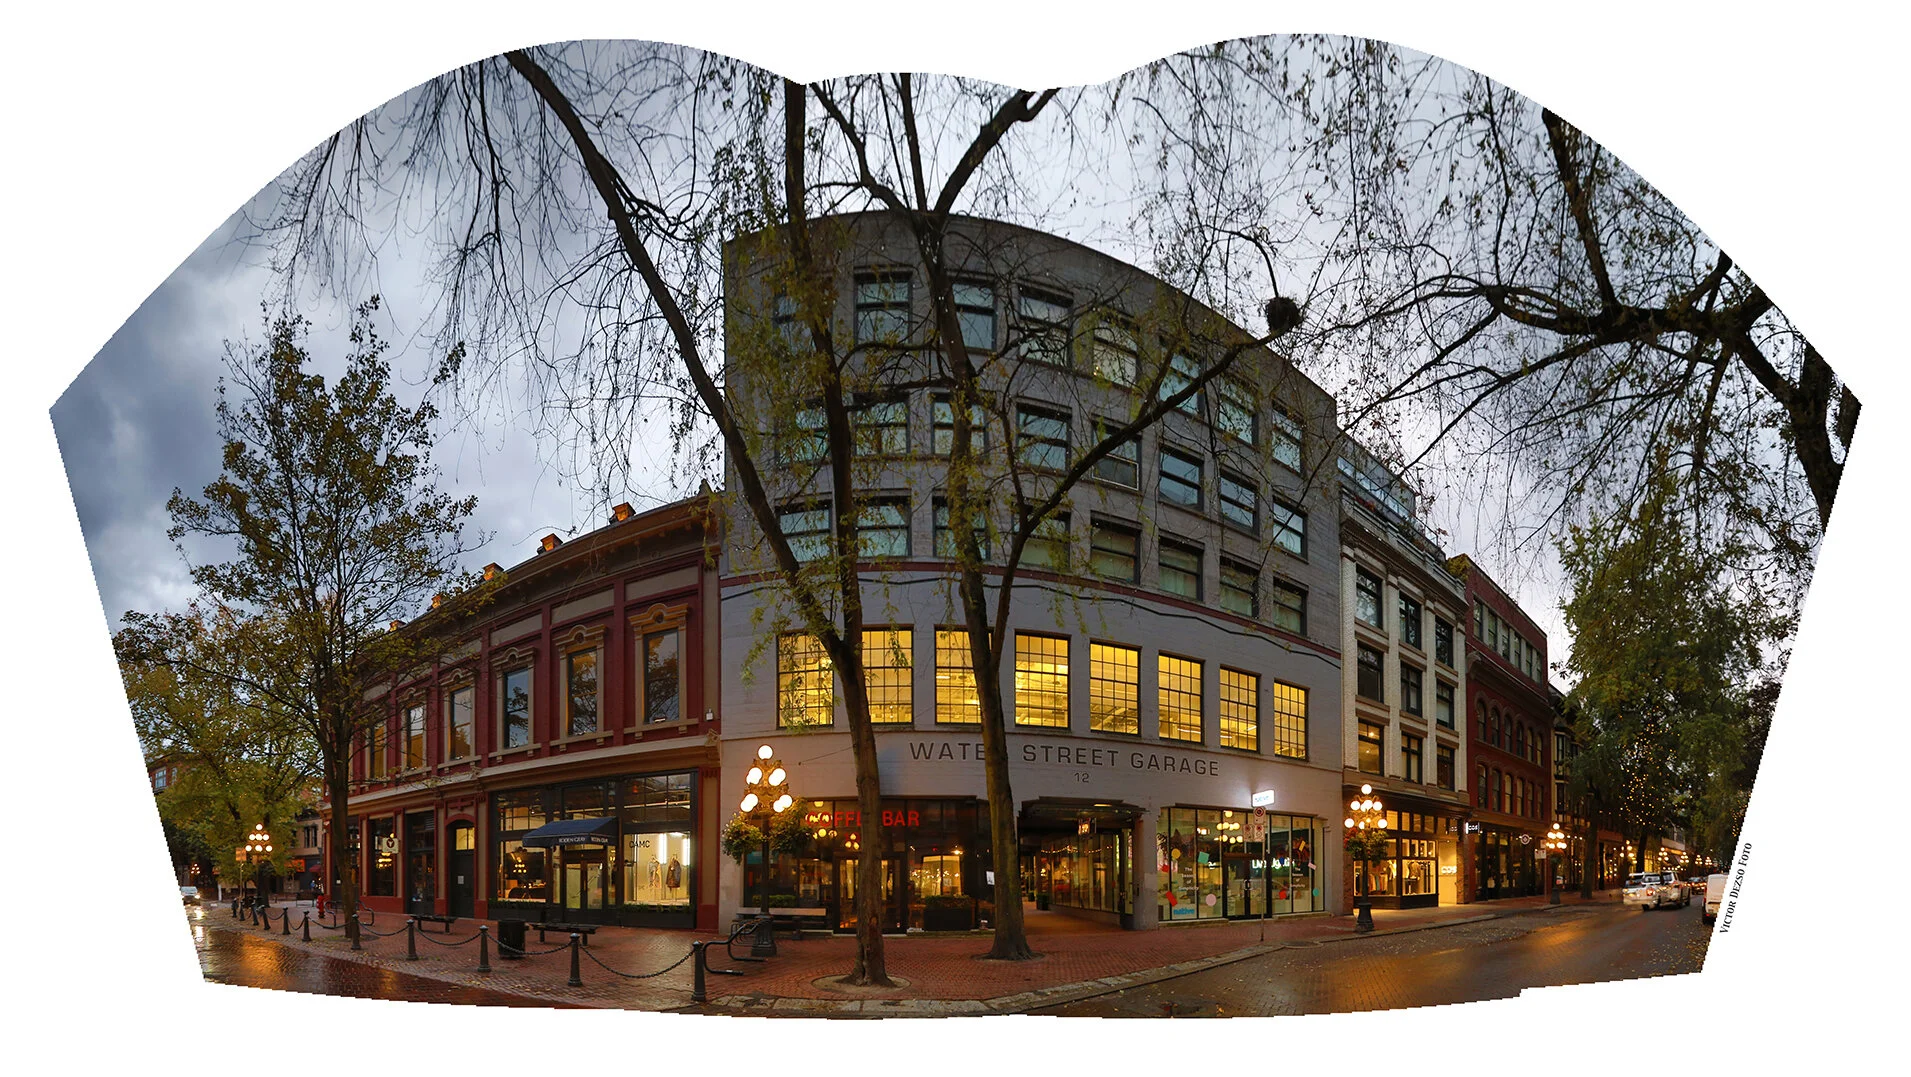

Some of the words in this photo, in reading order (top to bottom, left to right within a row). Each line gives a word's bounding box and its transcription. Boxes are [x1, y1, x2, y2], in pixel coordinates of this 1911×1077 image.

[910, 742, 985, 761] WATE
[1023, 744, 1119, 767] STREET
[1130, 752, 1219, 777] GARAGE
[1074, 772, 1089, 783] 12
[805, 810, 862, 827] COFF
[882, 810, 919, 827] BAR
